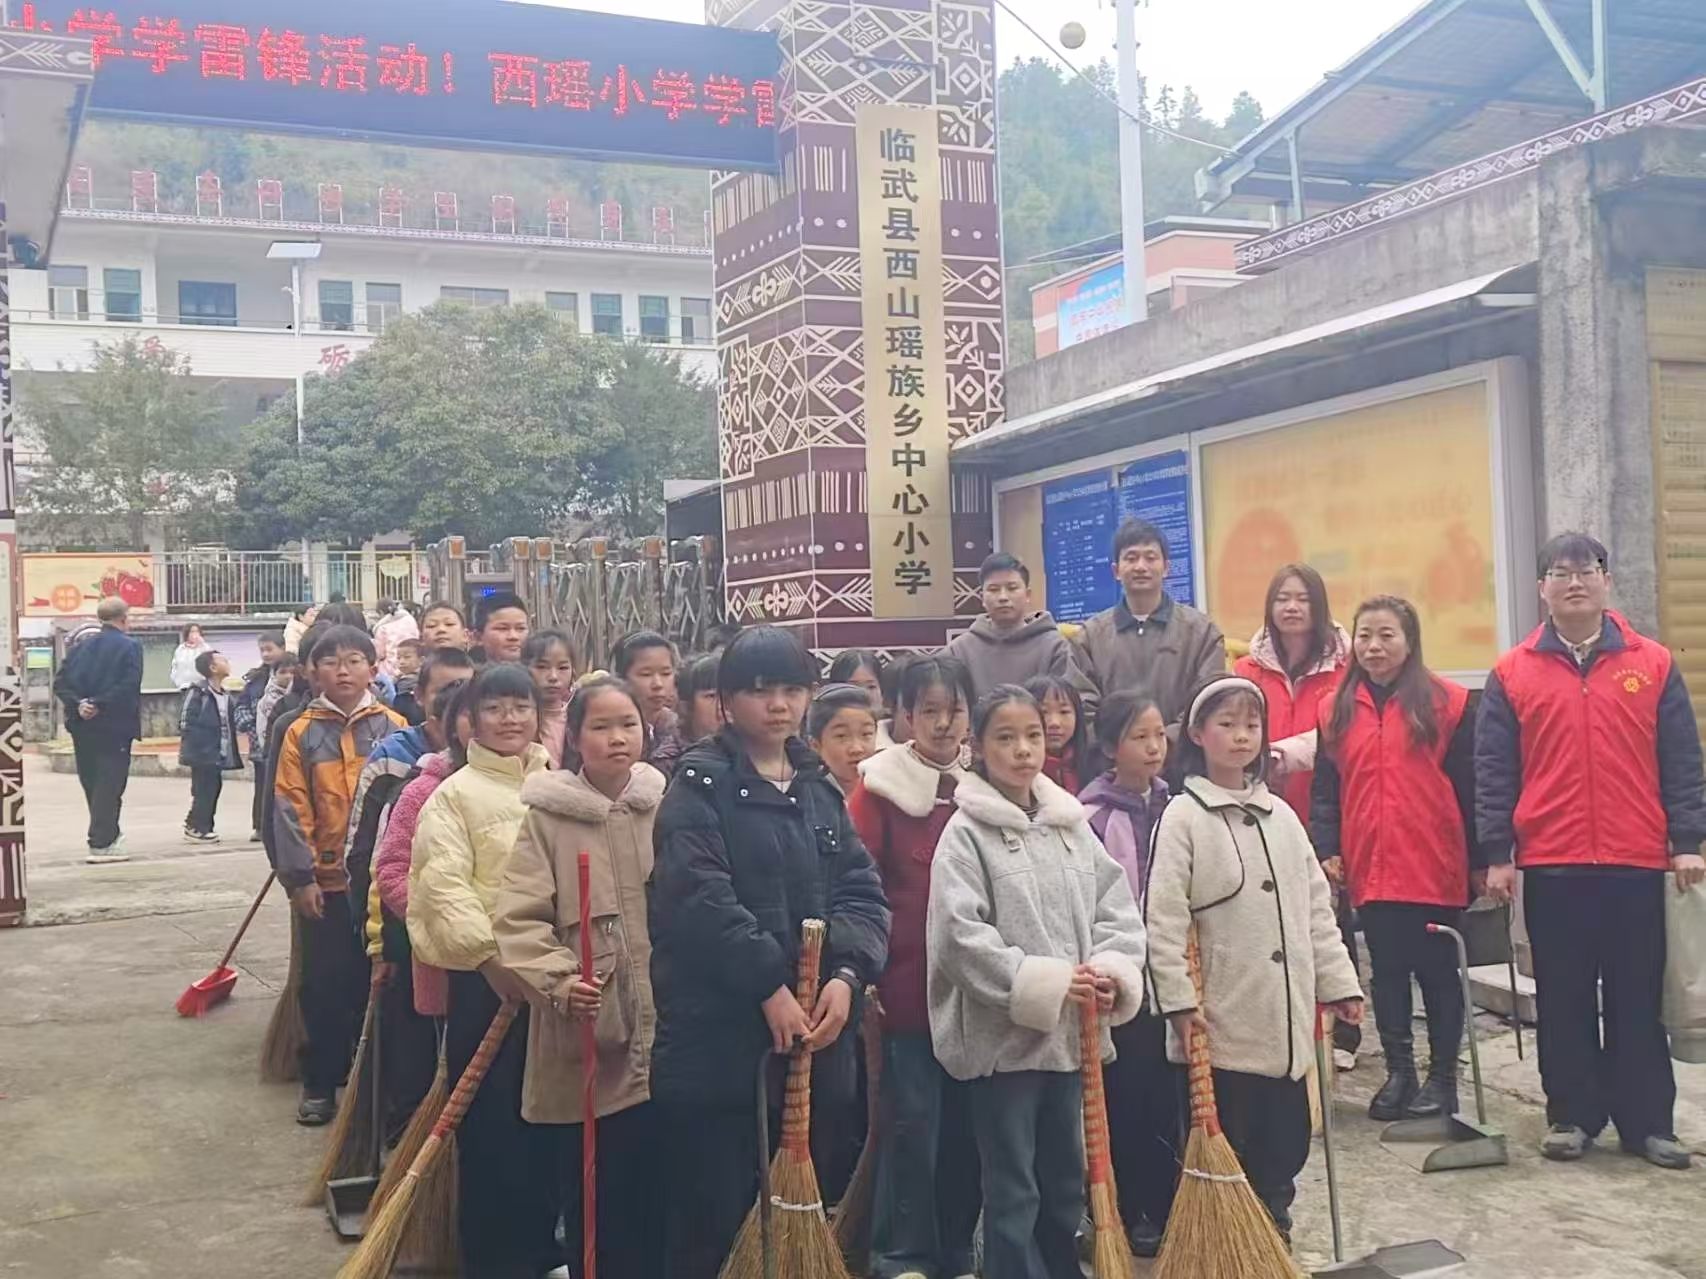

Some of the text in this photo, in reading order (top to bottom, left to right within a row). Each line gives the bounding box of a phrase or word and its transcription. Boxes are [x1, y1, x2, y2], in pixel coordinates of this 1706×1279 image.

[879, 127, 932, 596] 临武县西山瑶族乡中心小学
